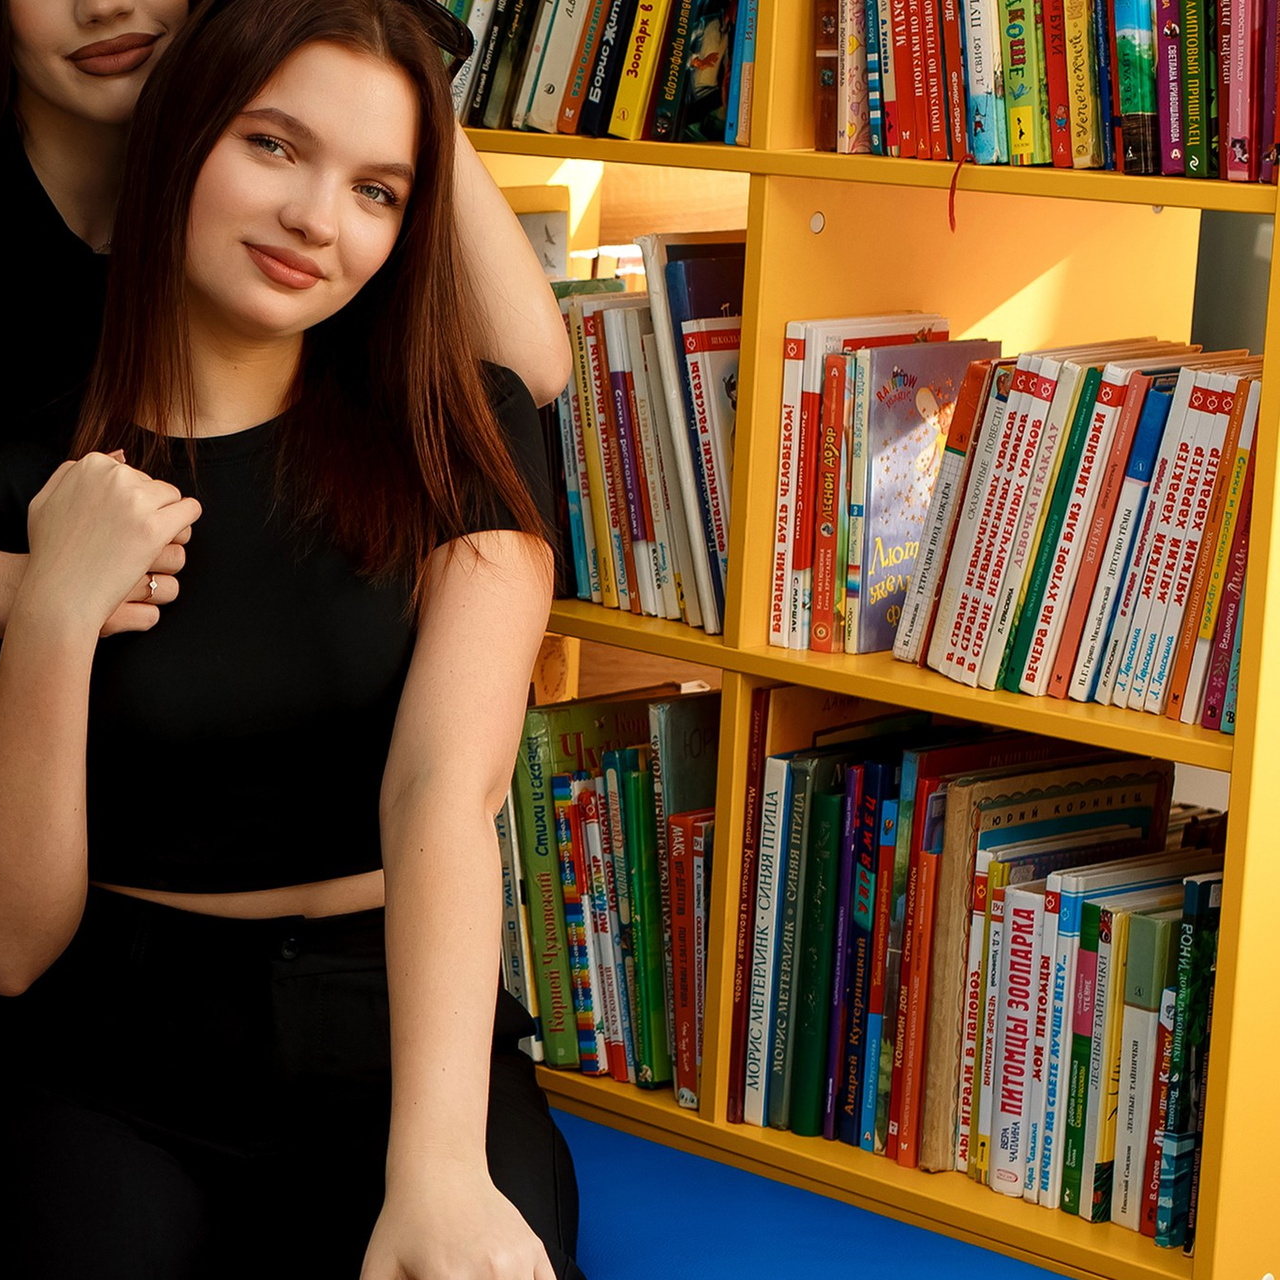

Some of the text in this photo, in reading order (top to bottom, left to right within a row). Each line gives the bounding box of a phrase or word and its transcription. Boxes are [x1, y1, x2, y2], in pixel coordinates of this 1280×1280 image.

[626, 15, 652, 78] Зоопарк
[642, 0, 654, 13] в
[1187, 79, 1201, 146] ПРИШЕЛЕЦ
[689, 360, 726, 553] ФАНТАСТИЧЕСКИЕ РАССКАЗЫ
[776, 502, 788, 541] БУДЬ
[780, 403, 795, 499] ЧЕЛОВЕКОМ!
[823, 426, 840, 521] ЛЕСНОЙ ДОЗОР
[1141, 441, 1189, 600] МЯГКИЙ ХАРАКТЕР
[968, 417, 1043, 673] В СТРАНЕ НЕВЫУЧЕННЫХ УРОКОВ
[1026, 411, 1107, 684] ВЕЧЕРА НА ХУТОРЕ БЛИЗ ДИКАНЬКИ
[1157, 445, 1205, 605] МЯГКИЙ ХАРАКТЕР
[1174, 447, 1221, 607] МЯГКИЙ ХАРАКТЕР
[991, 792, 1143, 827] ЮРИЙ КОРИНЕЦ
[747, 790, 780, 1091] МОРИС МЕТЕРЛИНК СИНЯЯ ПТИЦА
[843, 1055, 859, 1116] Андрей
[999, 907, 1036, 1163] ВЕРА ЧАПЛИНА ПИТОМЦЫ ЗООПАРКА
[1089, 955, 1108, 1090] ЛЕСНЫЕ ТАЙНИЧКИ
